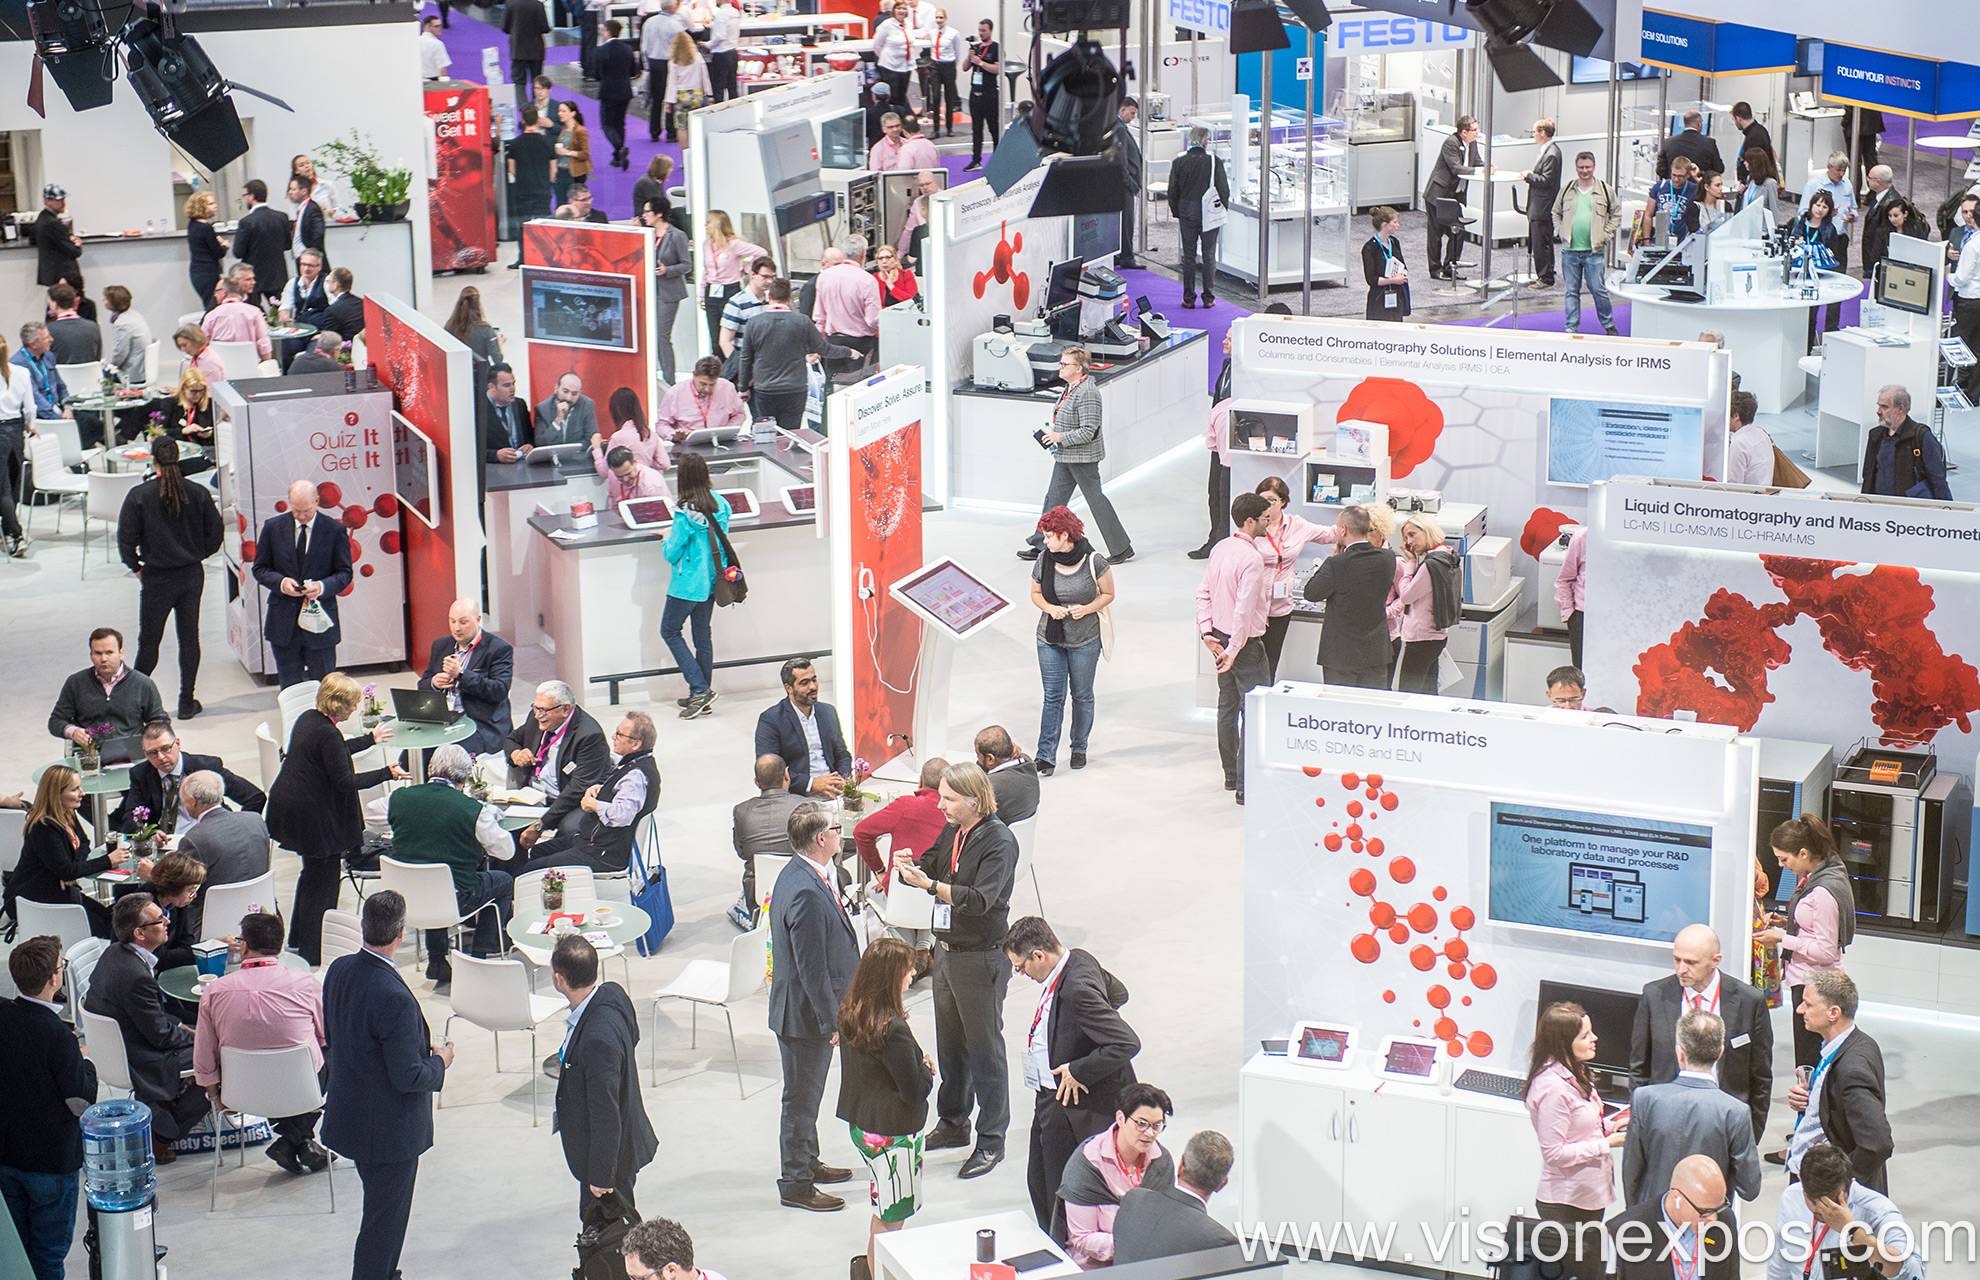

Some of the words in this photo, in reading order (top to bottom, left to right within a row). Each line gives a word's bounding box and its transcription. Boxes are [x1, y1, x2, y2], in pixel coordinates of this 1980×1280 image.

[1338, 18, 1467, 48] FESTO
[1655, 32, 1688, 47] SOLUTIONS
[1837, 66, 1864, 80] FOLLOW
[1864, 70, 1884, 84] YOUR
[1884, 75, 1921, 91] INSTINCTS
[463, 108, 476, 121] It
[437, 124, 462, 137] Get
[464, 123, 476, 136] It
[1258, 332, 1323, 347] Connected
[1326, 336, 1427, 356] Chromatography
[1430, 343, 1486, 358] Solutions
[1496, 348, 1557, 362] Elemental
[1560, 352, 1612, 367] Analysis
[1615, 355, 1633, 367] for
[1636, 357, 1671, 370] IRMS
[1258, 349, 1295, 361] Columns
[1297, 352, 1313, 361] and
[1315, 353, 1372, 366] Consumables
[1379, 357, 1420, 369] Elemental
[1422, 359, 1457, 372] Analysis
[309, 430, 358, 451] Quiz
[364, 428, 380, 447] It
[321, 452, 359, 472] Get
[366, 450, 381, 469] It
[1624, 498, 1670, 516] Liquid
[1673, 502, 1802, 528] Chromatography
[1805, 515, 1835, 529] and
[1839, 516, 1881, 533] Mass
[1623, 518, 1661, 533] LC-MS
[1669, 522, 1728, 538] LC-MS/MS
[1737, 528, 1816, 546] LC-HRAM-MS
[1287, 712, 1382, 740] Laboratory
[1388, 723, 1488, 748] Informatics
[1286, 737, 1321, 754] LIMS,
[1325, 740, 1365, 757] SDMS
[1368, 747, 1392, 760] and
[1396, 749, 1422, 763] ELN
[1521, 833, 1543, 844] One
[1544, 836, 1585, 849] platform
[1588, 841, 1598, 851] to
[1600, 844, 1640, 857] manage
[1642, 849, 1664, 859] your
[1666, 851, 1690, 861] R&D
[1531, 845, 1581, 861] laboratory
[1582, 851, 1605, 861] data
[1607, 855, 1626, 865] and
[1628, 859, 1680, 871] processes
